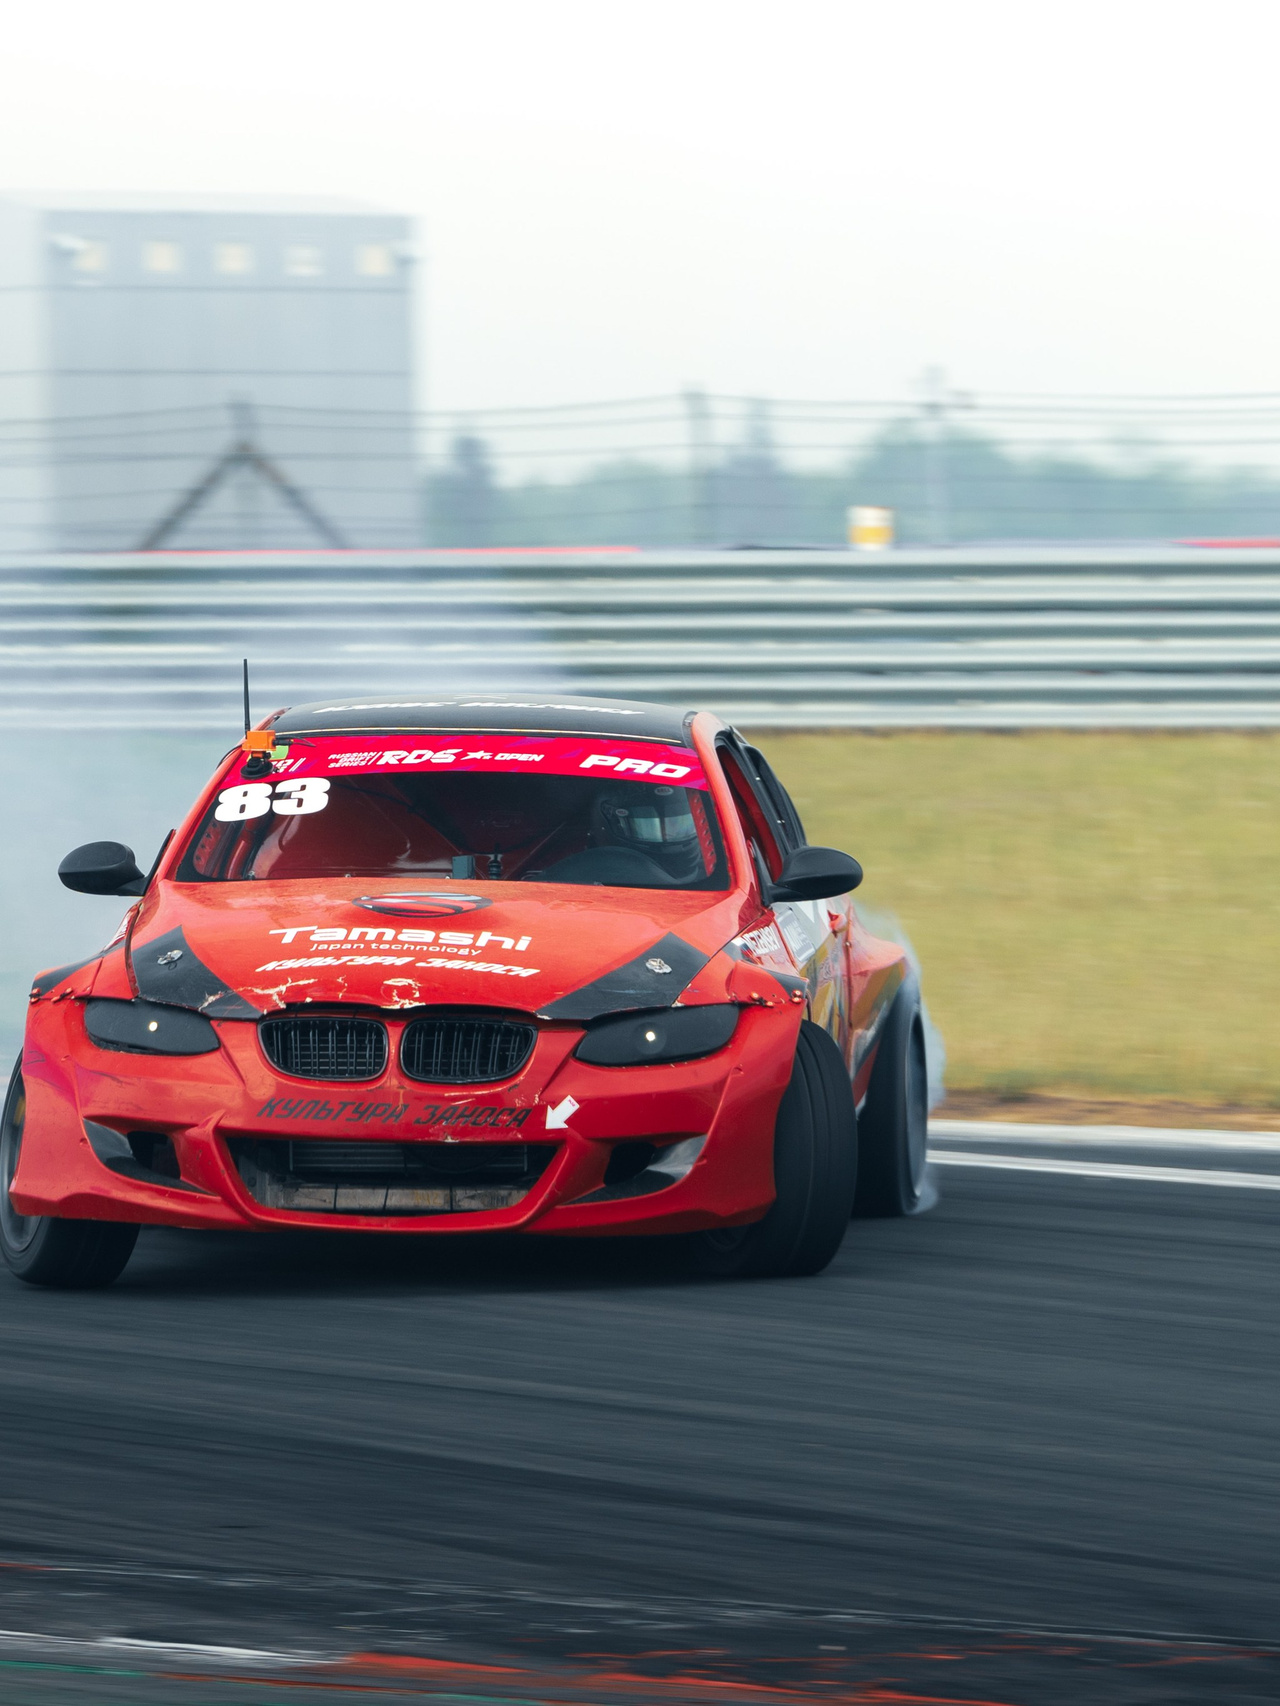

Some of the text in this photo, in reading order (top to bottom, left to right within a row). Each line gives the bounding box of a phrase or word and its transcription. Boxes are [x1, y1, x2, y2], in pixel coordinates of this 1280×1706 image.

[376, 748, 692, 779] RDS OPEN PRO
[214, 777, 331, 822] 83
[268, 925, 533, 952] Tamashi
[309, 942, 483, 957] japan technology
[255, 955, 541, 978] КУЛЬТУРА ЗАНОСА
[256, 1097, 533, 1128] КУЛЬТУРА ЗАНОСА
